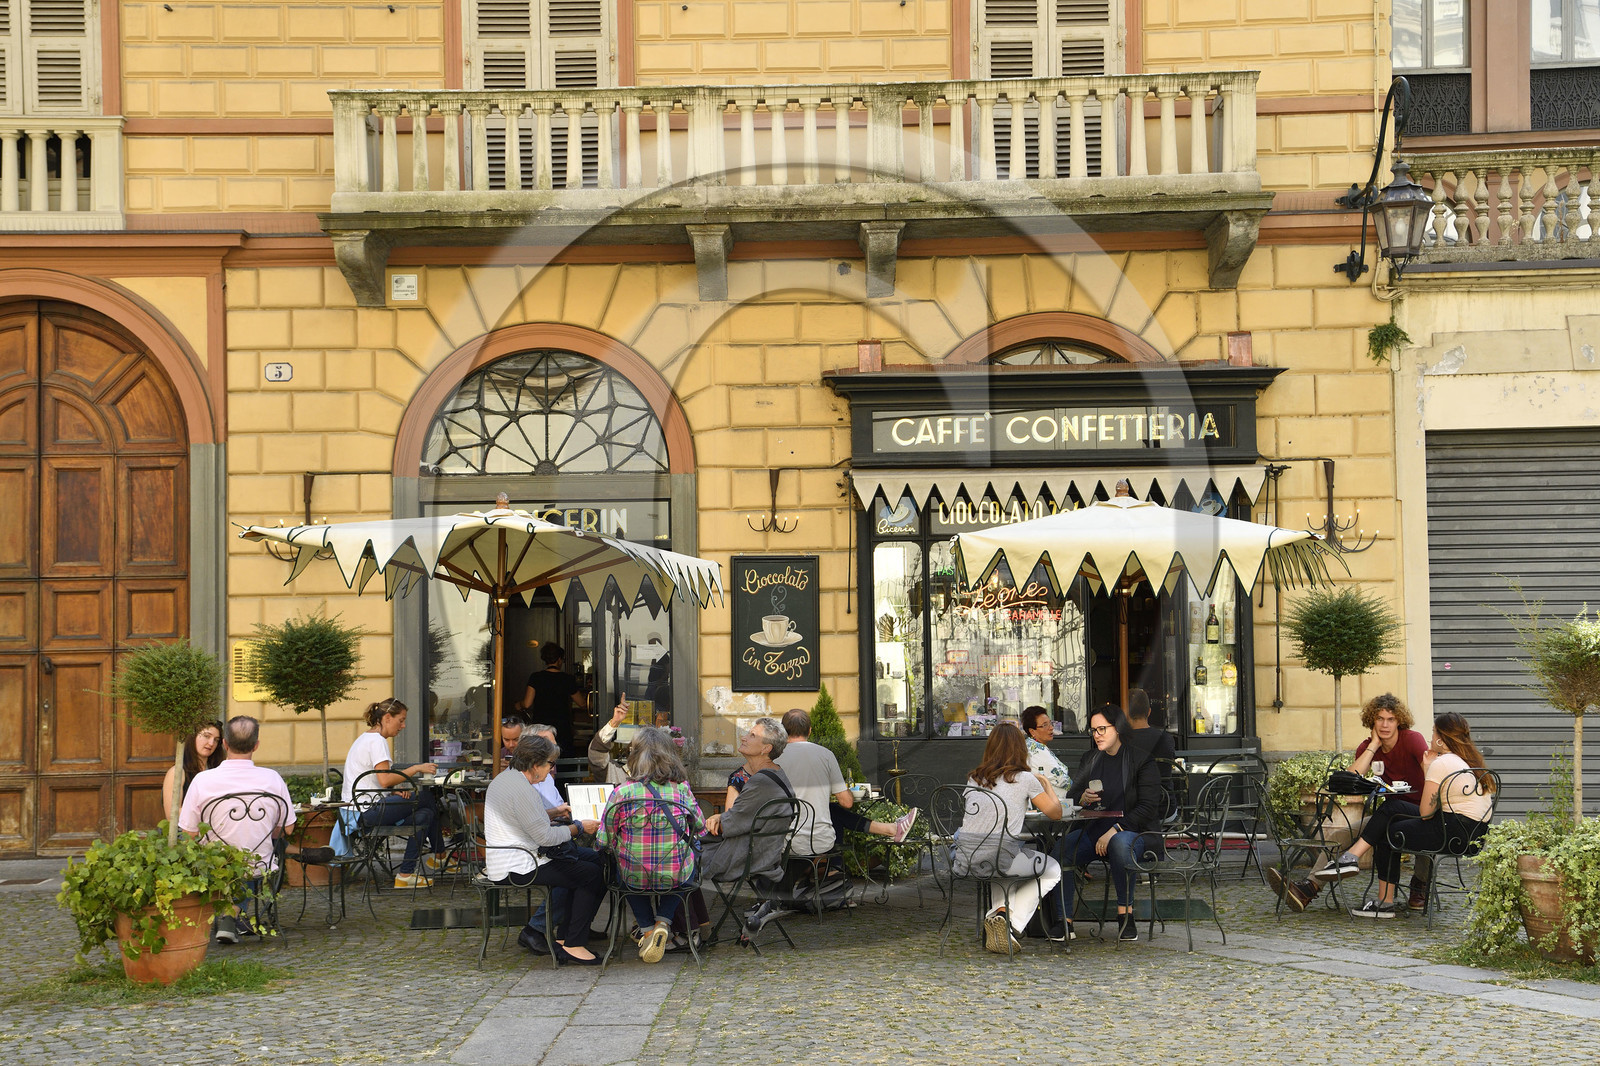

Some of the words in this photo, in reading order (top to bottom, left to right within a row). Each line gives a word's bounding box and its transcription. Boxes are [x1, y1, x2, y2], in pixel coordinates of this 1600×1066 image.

[274, 366, 283, 379] 5
[1005, 412, 1221, 445] CONFETTERIA
[876, 518, 917, 535] Bicerin
[741, 565, 809, 594] Cioccolato
[763, 646, 811, 681] Tazza
